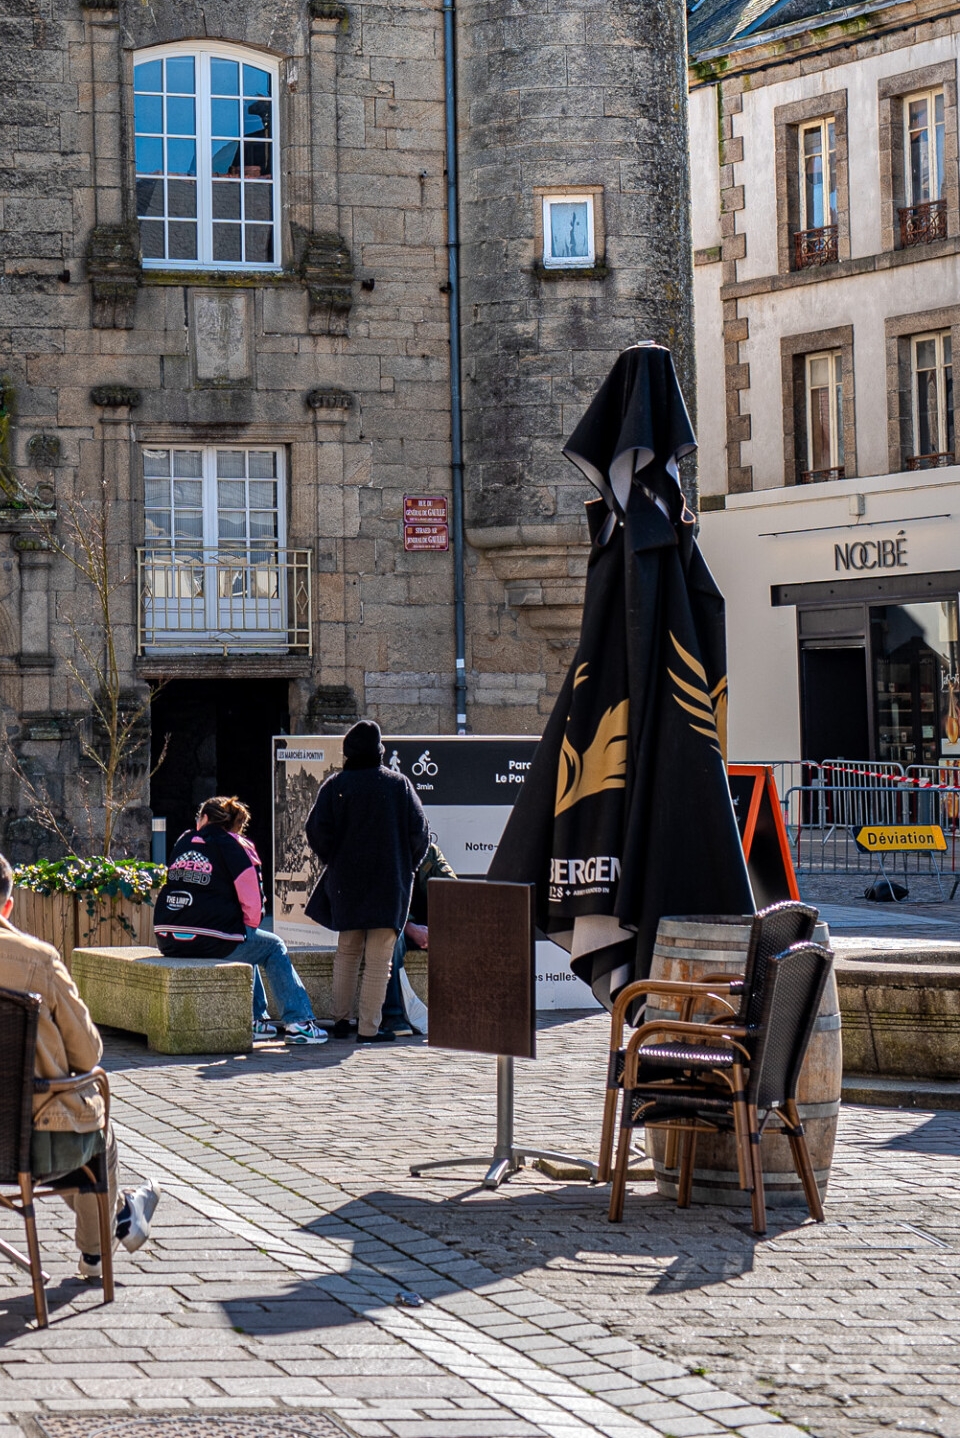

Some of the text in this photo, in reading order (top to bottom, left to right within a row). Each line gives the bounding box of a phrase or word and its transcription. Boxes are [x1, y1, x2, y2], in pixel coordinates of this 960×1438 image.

[428, 508, 446, 517] GAULLE
[428, 535, 446, 544] GAULLE
[834, 529, 908, 571] NOCIBÉ
[284, 749, 303, 760] MARCHÉS
[306, 751, 324, 760] PONTIVY
[495, 773, 507, 783] Le
[867, 831, 934, 845] Déviation
[169, 860, 213, 874] SPEED
[168, 869, 212, 886] SPEED
[166, 895, 190, 905] THE LIMIT
[545, 972, 577, 982] Halles
